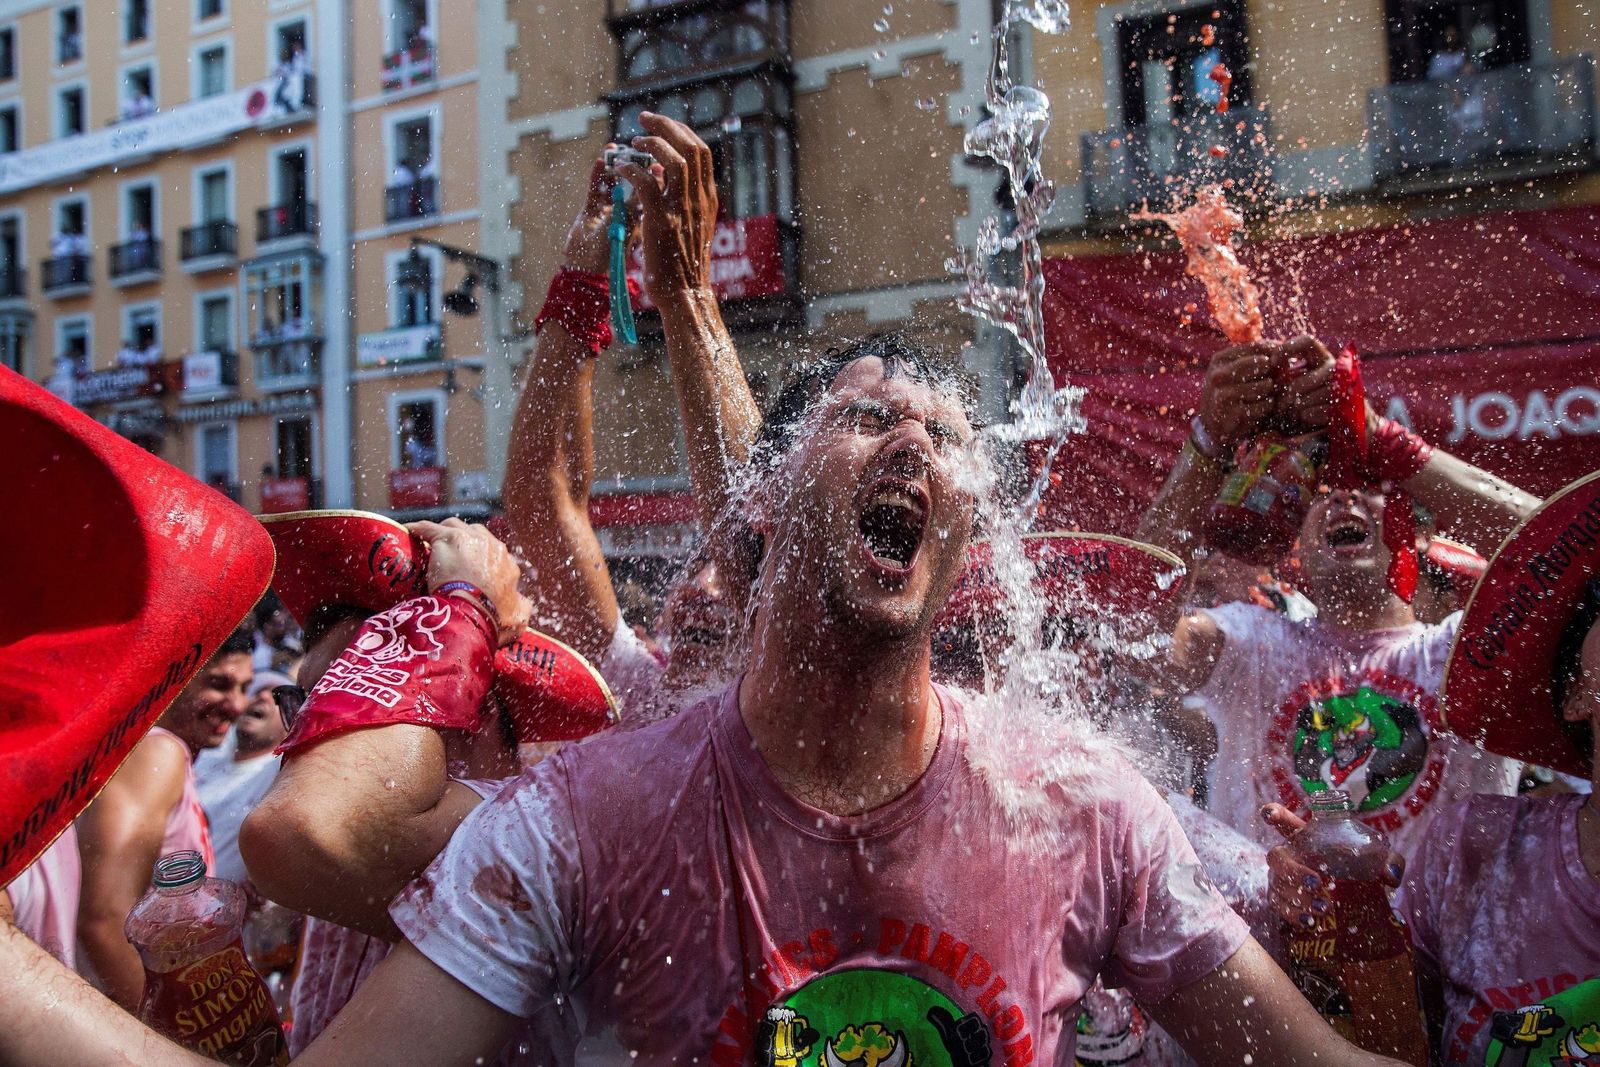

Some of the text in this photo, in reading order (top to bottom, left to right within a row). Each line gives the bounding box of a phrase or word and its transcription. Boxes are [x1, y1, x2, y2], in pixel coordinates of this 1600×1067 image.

[1446, 386, 1600, 443] JOAQ
[190, 961, 235, 1001] DON
[877, 917, 1036, 1067] PAMPLON
